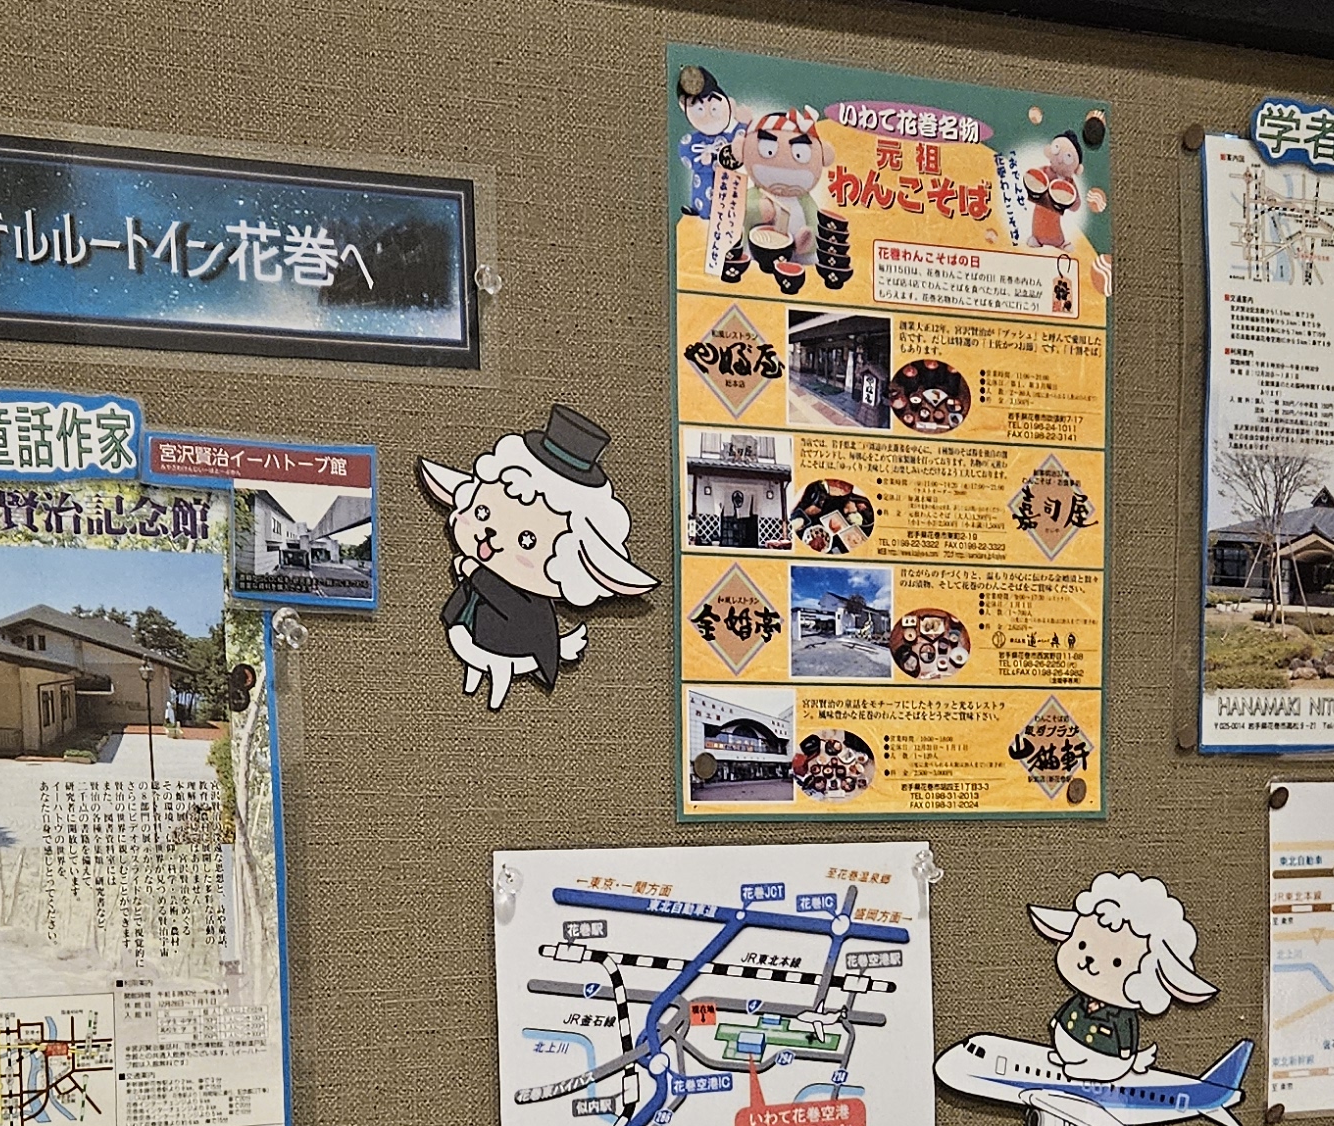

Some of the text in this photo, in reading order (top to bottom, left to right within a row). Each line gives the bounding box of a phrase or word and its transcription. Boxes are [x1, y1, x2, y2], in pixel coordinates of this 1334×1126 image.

[839, 102, 981, 143] いわて花巻名物
[876, 140, 941, 175] 元祖
[828, 165, 992, 219] わんこそば
[878, 247, 980, 268] 花巻わんこそばの日
[1008, 421, 1021, 429] TEL
[1008, 431, 1022, 439] FAX
[159, 444, 347, 476] 宮沢賢治イーハトーブ館
[1012, 486, 1099, 531] 嘉司屋
[879, 538, 890, 547] TEL
[944, 541, 958, 549] FAX
[692, 603, 783, 644] 金婚亭
[999, 660, 1011, 668] TEL
[1218, 697, 1301, 716] HANAMAKI
[1008, 733, 1089, 772] 山猫軒
[911, 792, 923, 800] TEL
[910, 801, 923, 809] FAX
[825, 867, 892, 885] 至花巻温泉郷
[588, 876, 673, 896] 東京・一関方面
[742, 885, 783, 901] 花巻JCT
[800, 895, 834, 910] 花巻IC
[1273, 890, 1322, 901] JR東北本線
[647, 899, 716, 917] 東北自動車道
[854, 908, 901, 923] 盛岡方面
[567, 923, 606, 937] 花巻駅
[741, 952, 801, 968] JR東北本線
[846, 952, 901, 968] 花巻空港駅
[587, 985, 597, 996] 4
[563, 1013, 616, 1028] JR釜石線
[534, 1042, 569, 1055] 北上川
[1272, 1055, 1315, 1066] 東北新幹線
[516, 1071, 595, 1103] 花巻東バイパス
[672, 1076, 731, 1093] 花巻空港IC
[576, 1099, 612, 1115] 似内駅
[749, 1105, 849, 1126] いわて花巻空港
